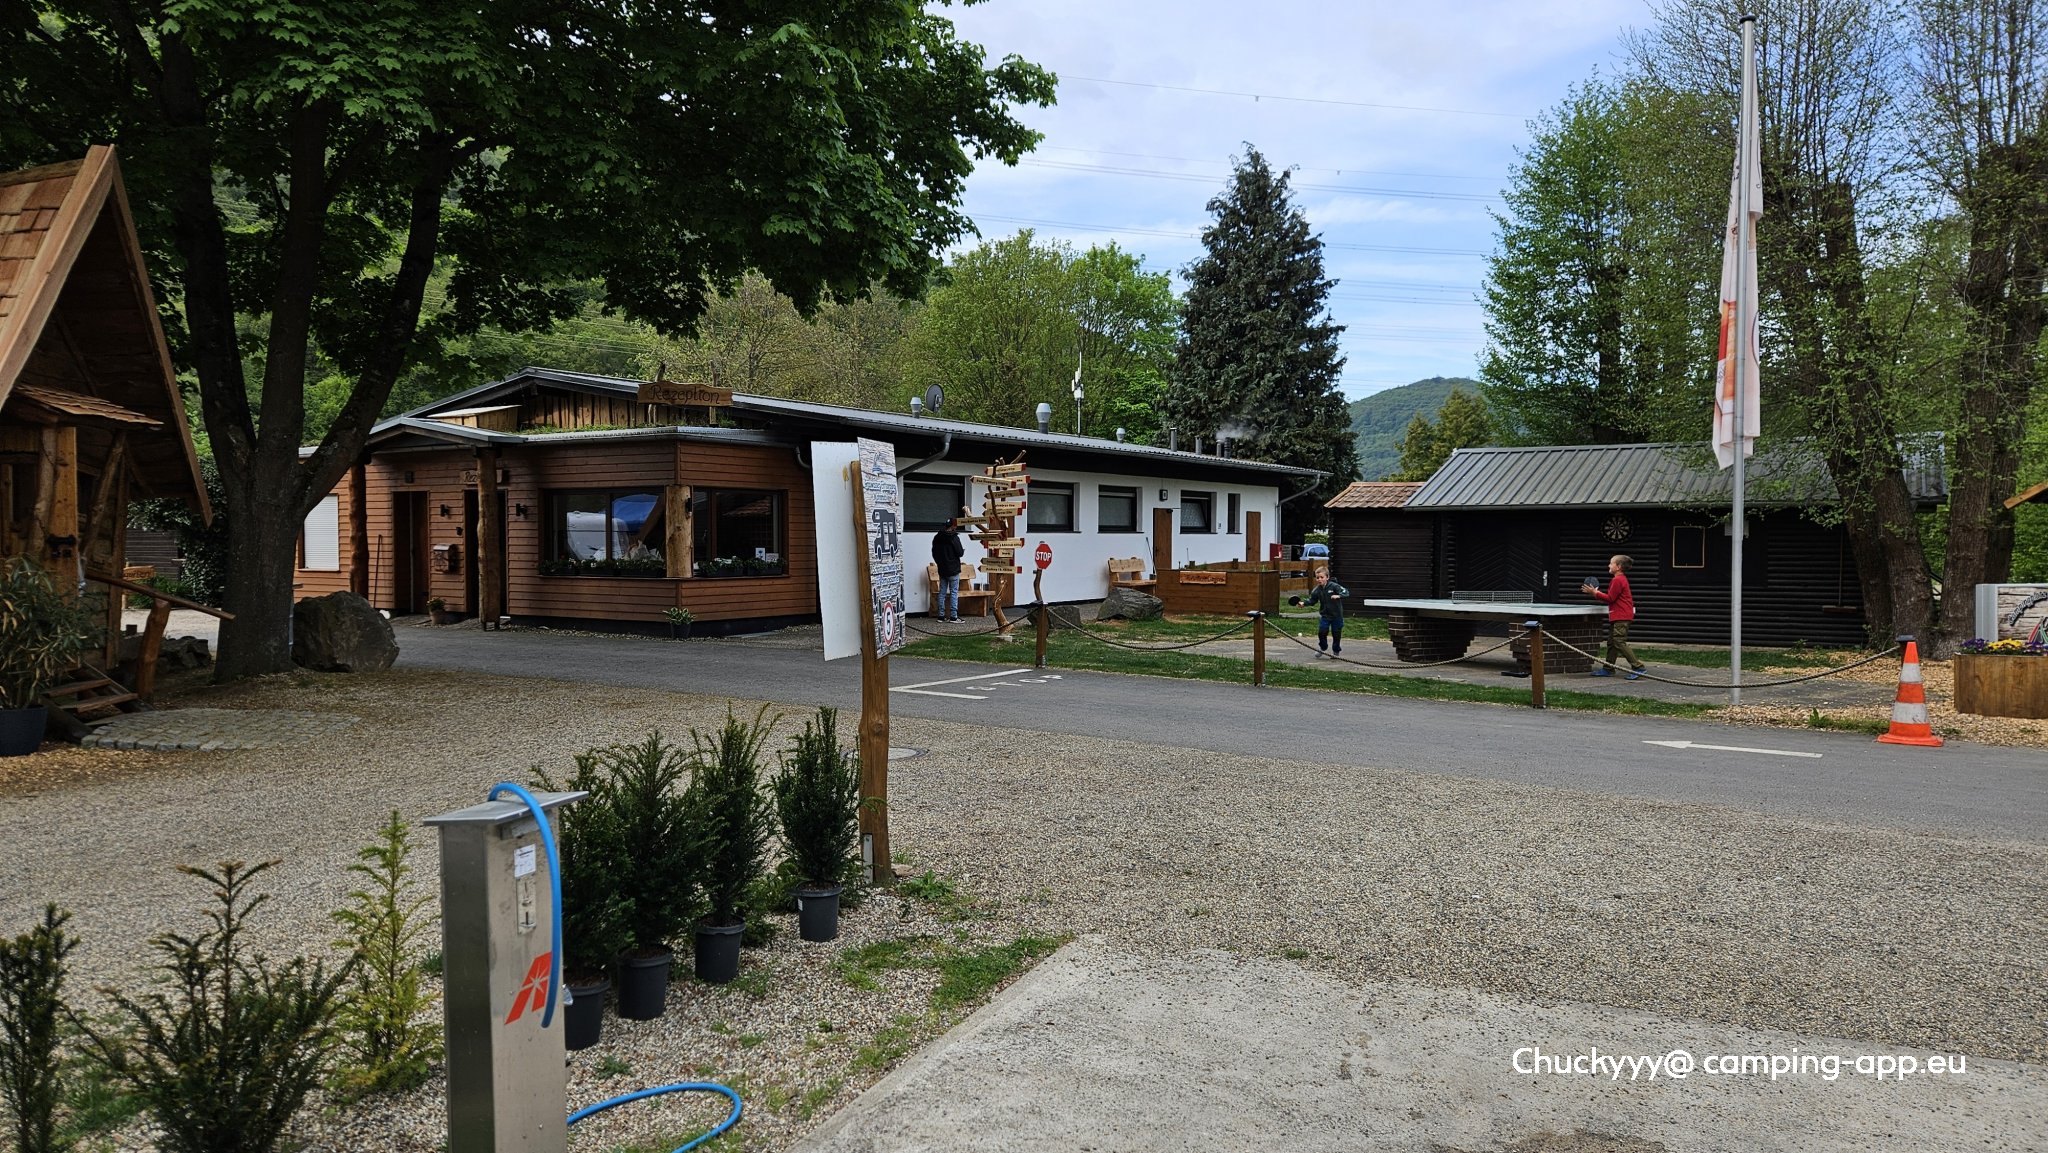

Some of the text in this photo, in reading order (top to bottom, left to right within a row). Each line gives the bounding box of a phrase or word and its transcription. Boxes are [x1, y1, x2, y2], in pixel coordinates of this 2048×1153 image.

[649, 385, 720, 404] Rezeption
[1035, 551, 1051, 561] STOP
[886, 611, 891, 636] 5
